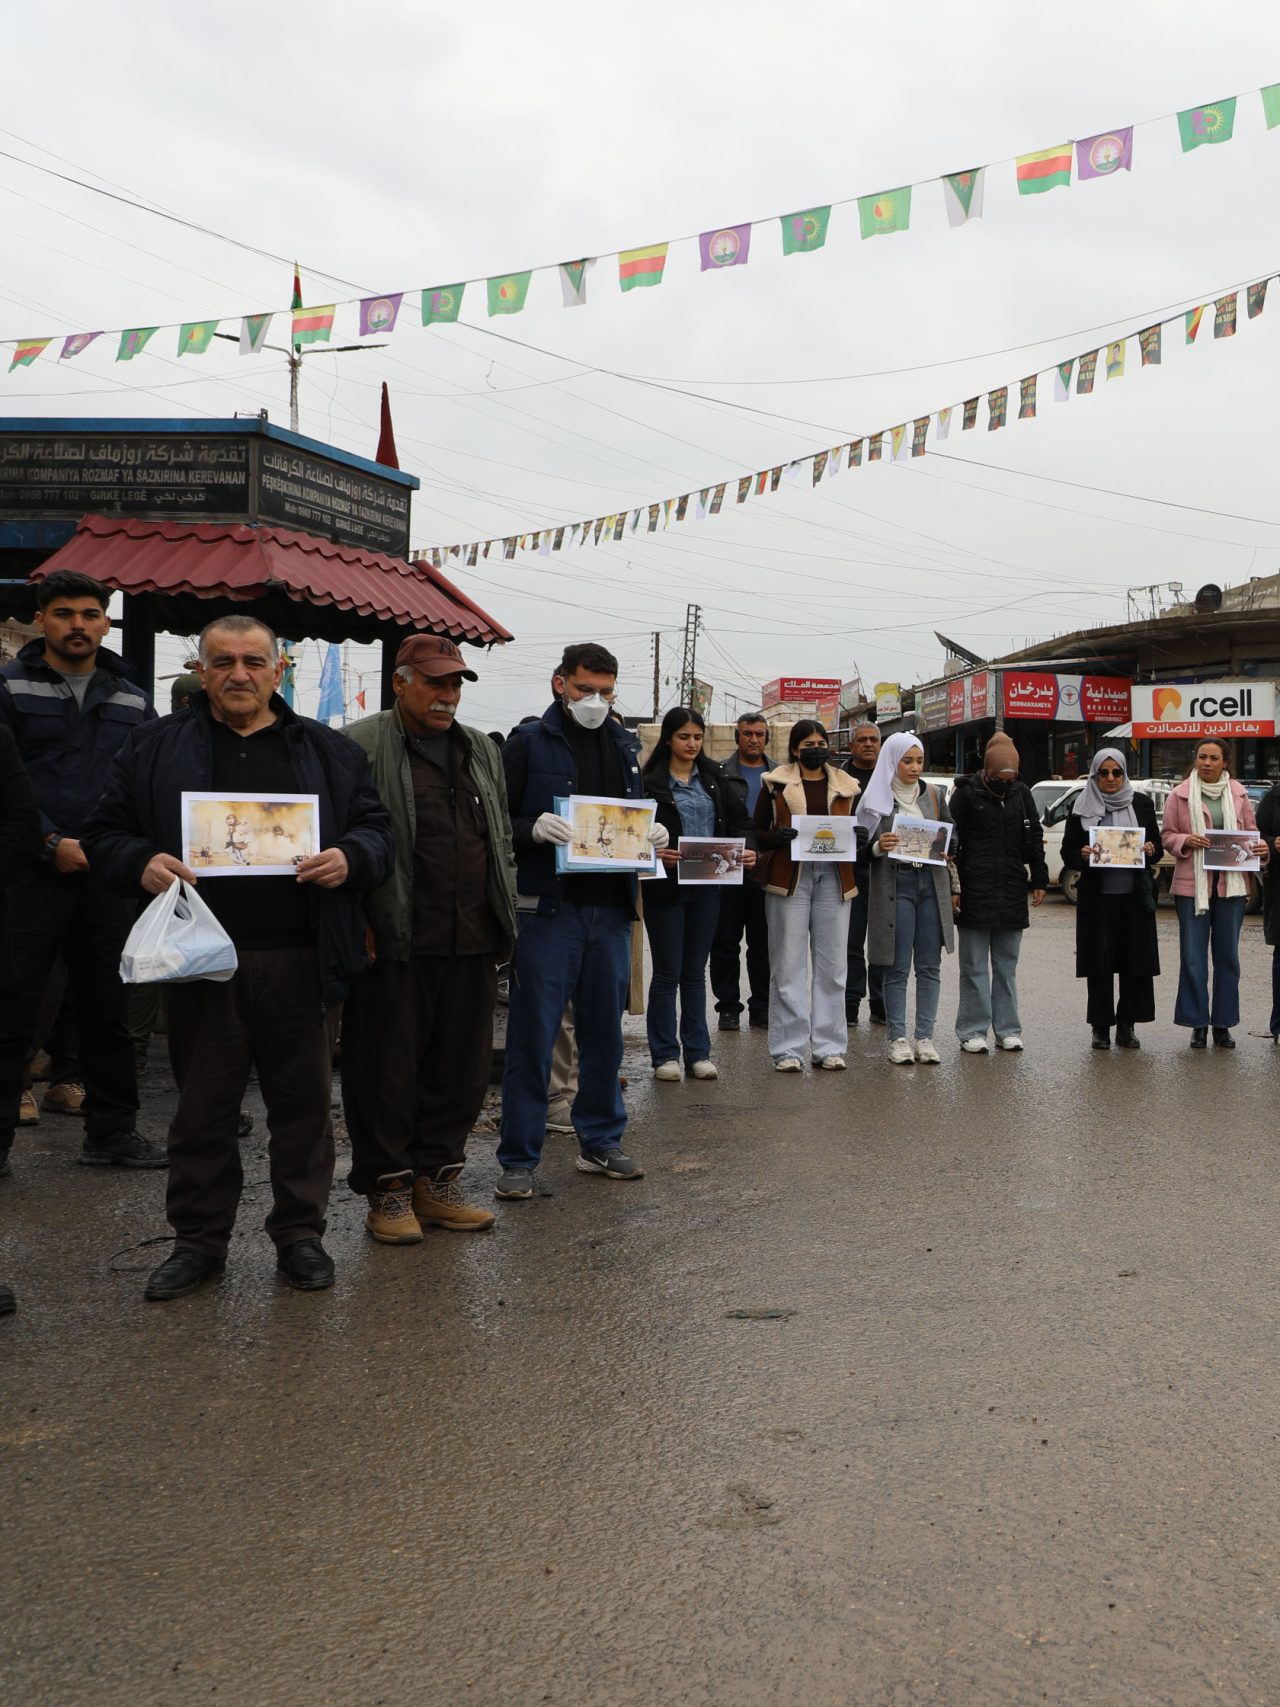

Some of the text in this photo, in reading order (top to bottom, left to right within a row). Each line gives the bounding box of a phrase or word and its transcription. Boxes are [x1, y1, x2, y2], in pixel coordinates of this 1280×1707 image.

[145, 441, 194, 465] شركة
[122, 469, 134, 483] YA
[136, 469, 186, 484] SAZKIRINA
[188, 471, 246, 485] KEREVANAN
[1009, 681, 1128, 703] صيدلية بدرخان
[1190, 689, 1252, 717] rcell
[1146, 722, 1260, 735] بهاء الدين للاتصالات
